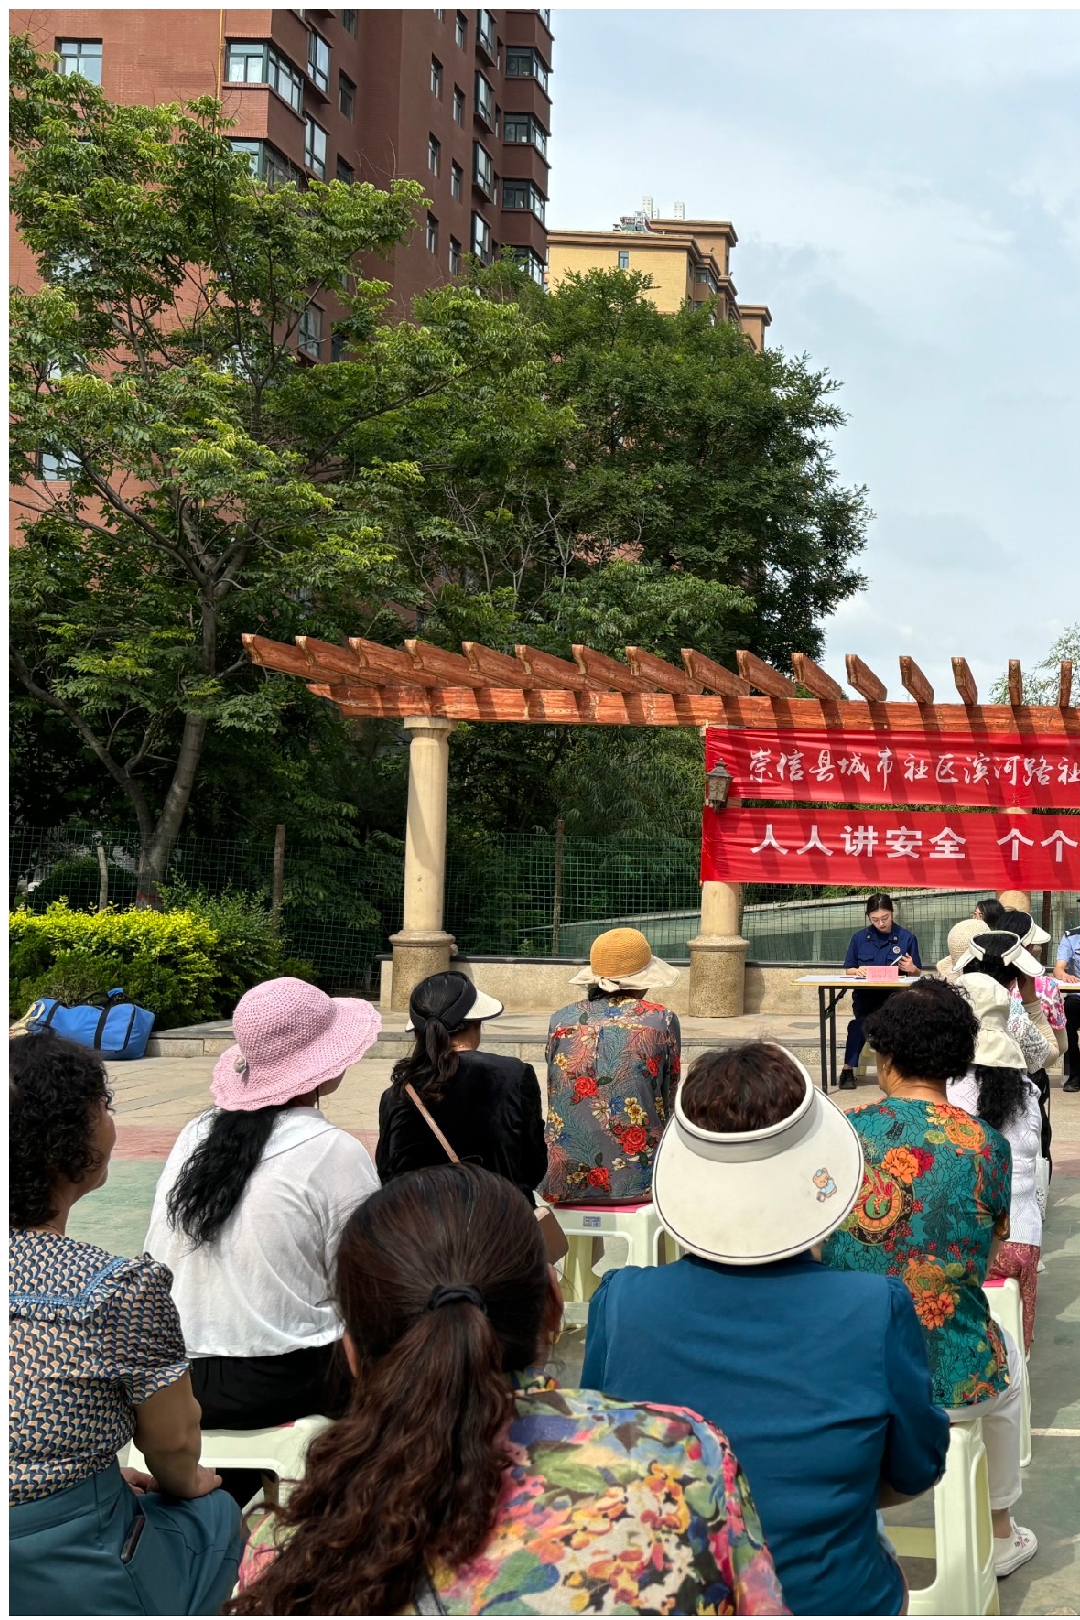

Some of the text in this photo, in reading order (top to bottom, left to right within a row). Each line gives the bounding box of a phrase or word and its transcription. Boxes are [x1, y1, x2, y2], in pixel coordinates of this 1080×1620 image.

[750, 823, 967, 860] 人人讲安全
